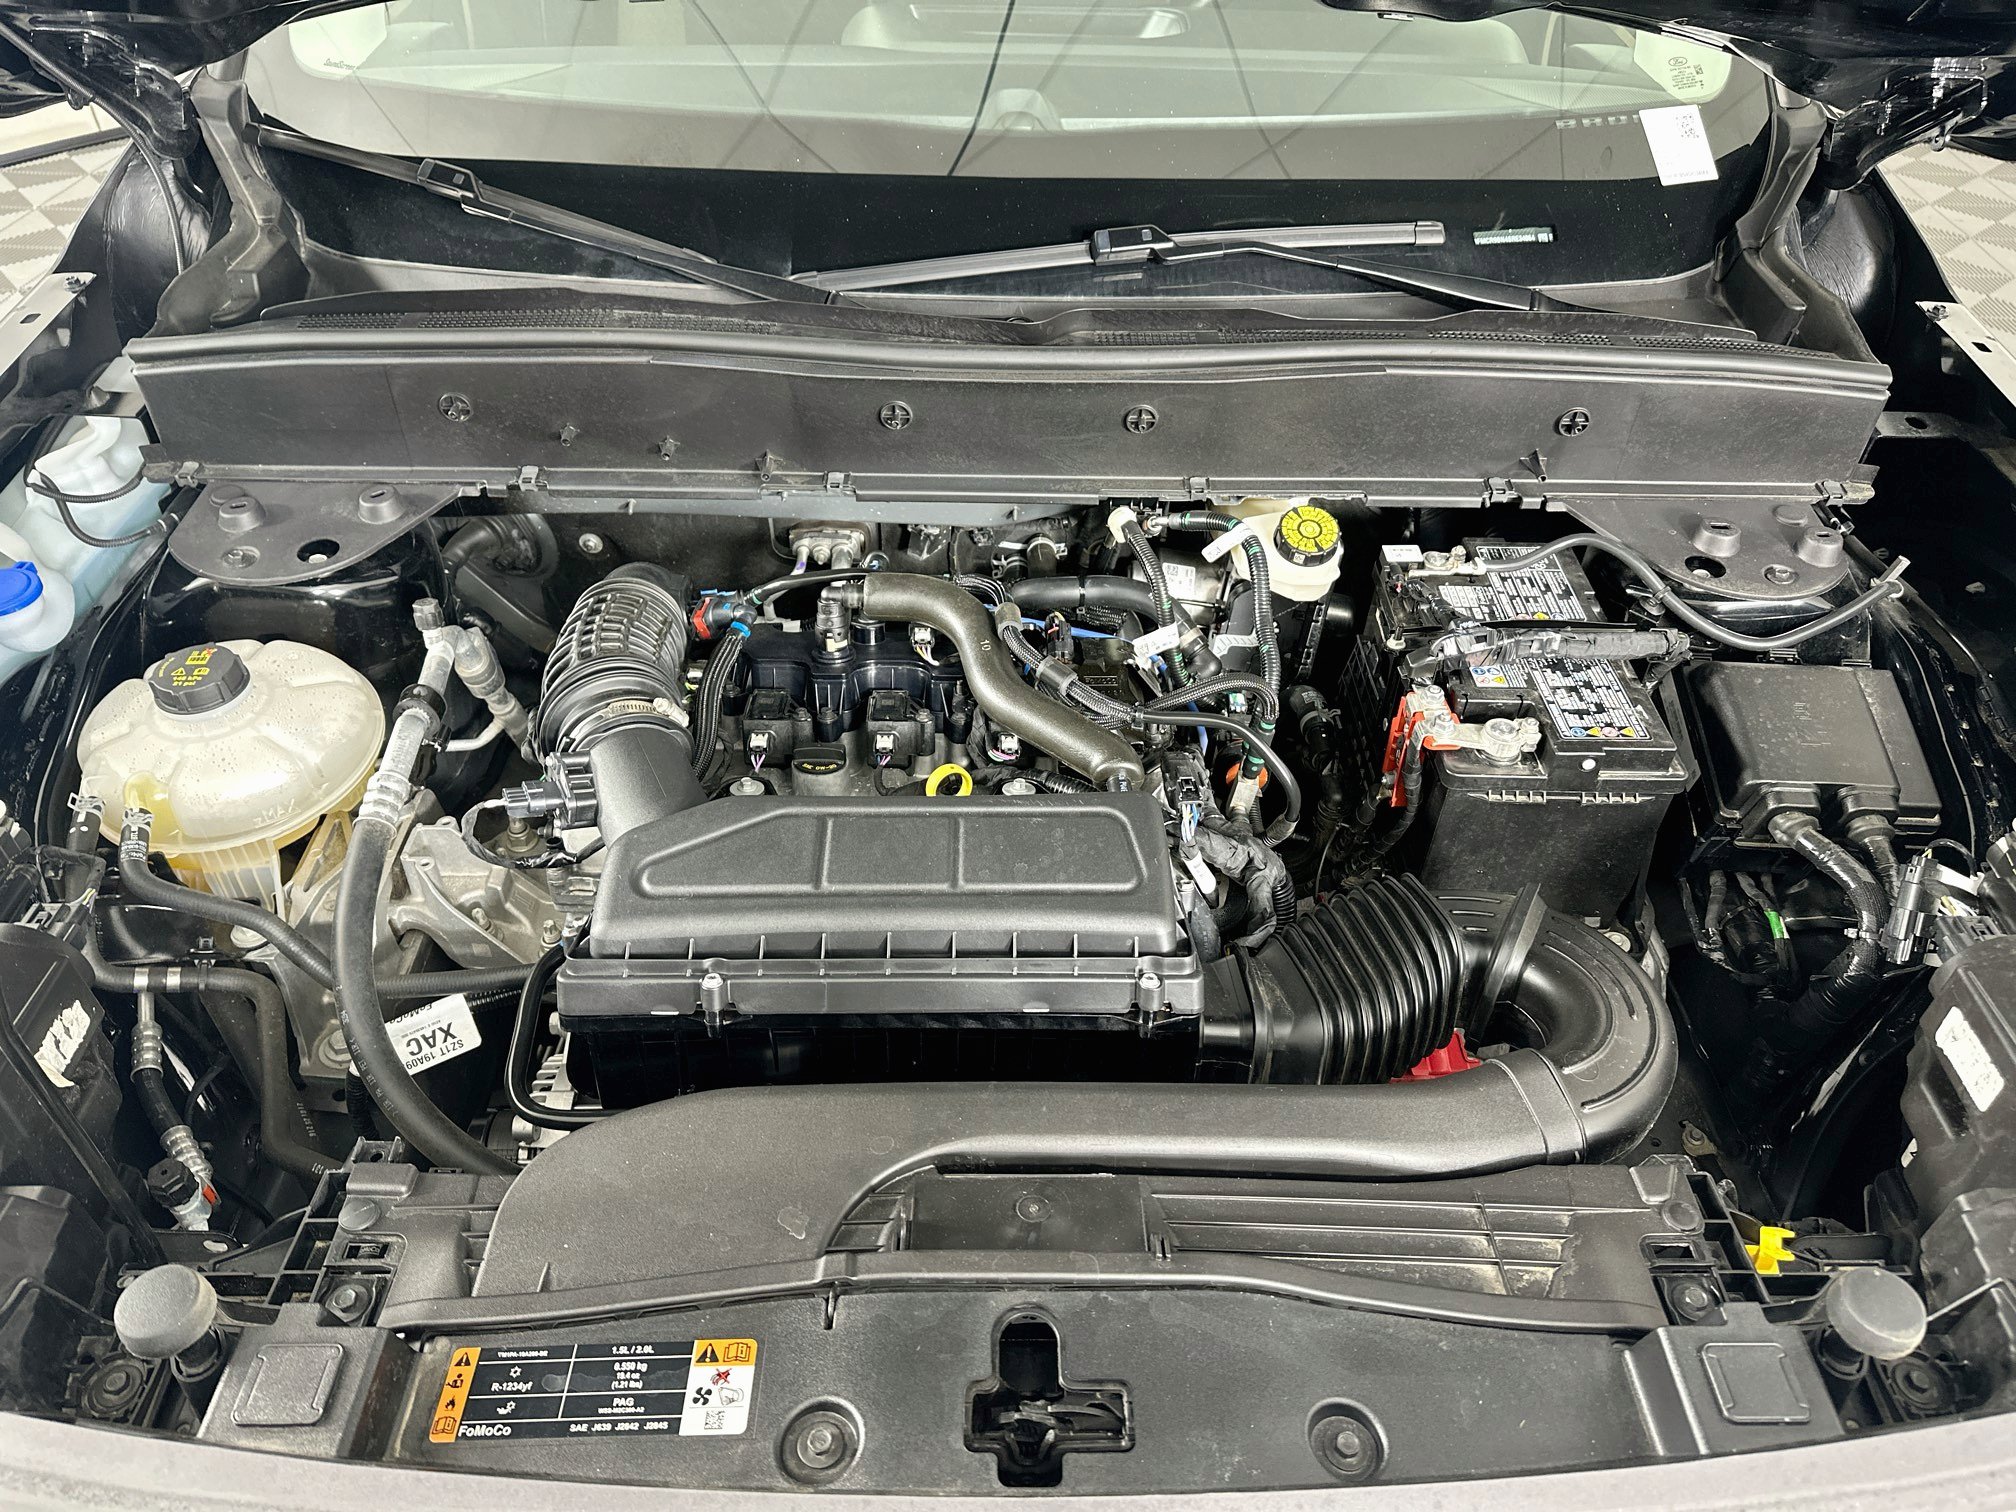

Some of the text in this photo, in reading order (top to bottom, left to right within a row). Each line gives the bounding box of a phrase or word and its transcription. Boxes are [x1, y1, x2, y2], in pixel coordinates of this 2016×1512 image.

[406, 1022, 457, 1056] XAC
[405, 1051, 436, 1070] 19A09
[612, 1346, 630, 1354] 1.5L
[636, 1344, 655, 1354] 2.0L
[613, 1361, 648, 1373] 0.550 kg
[491, 1381, 534, 1393] R-1234yf
[612, 1397, 634, 1406] PAG
[458, 1424, 512, 1437] FoMoCo
[569, 1423, 588, 1432] SAE
